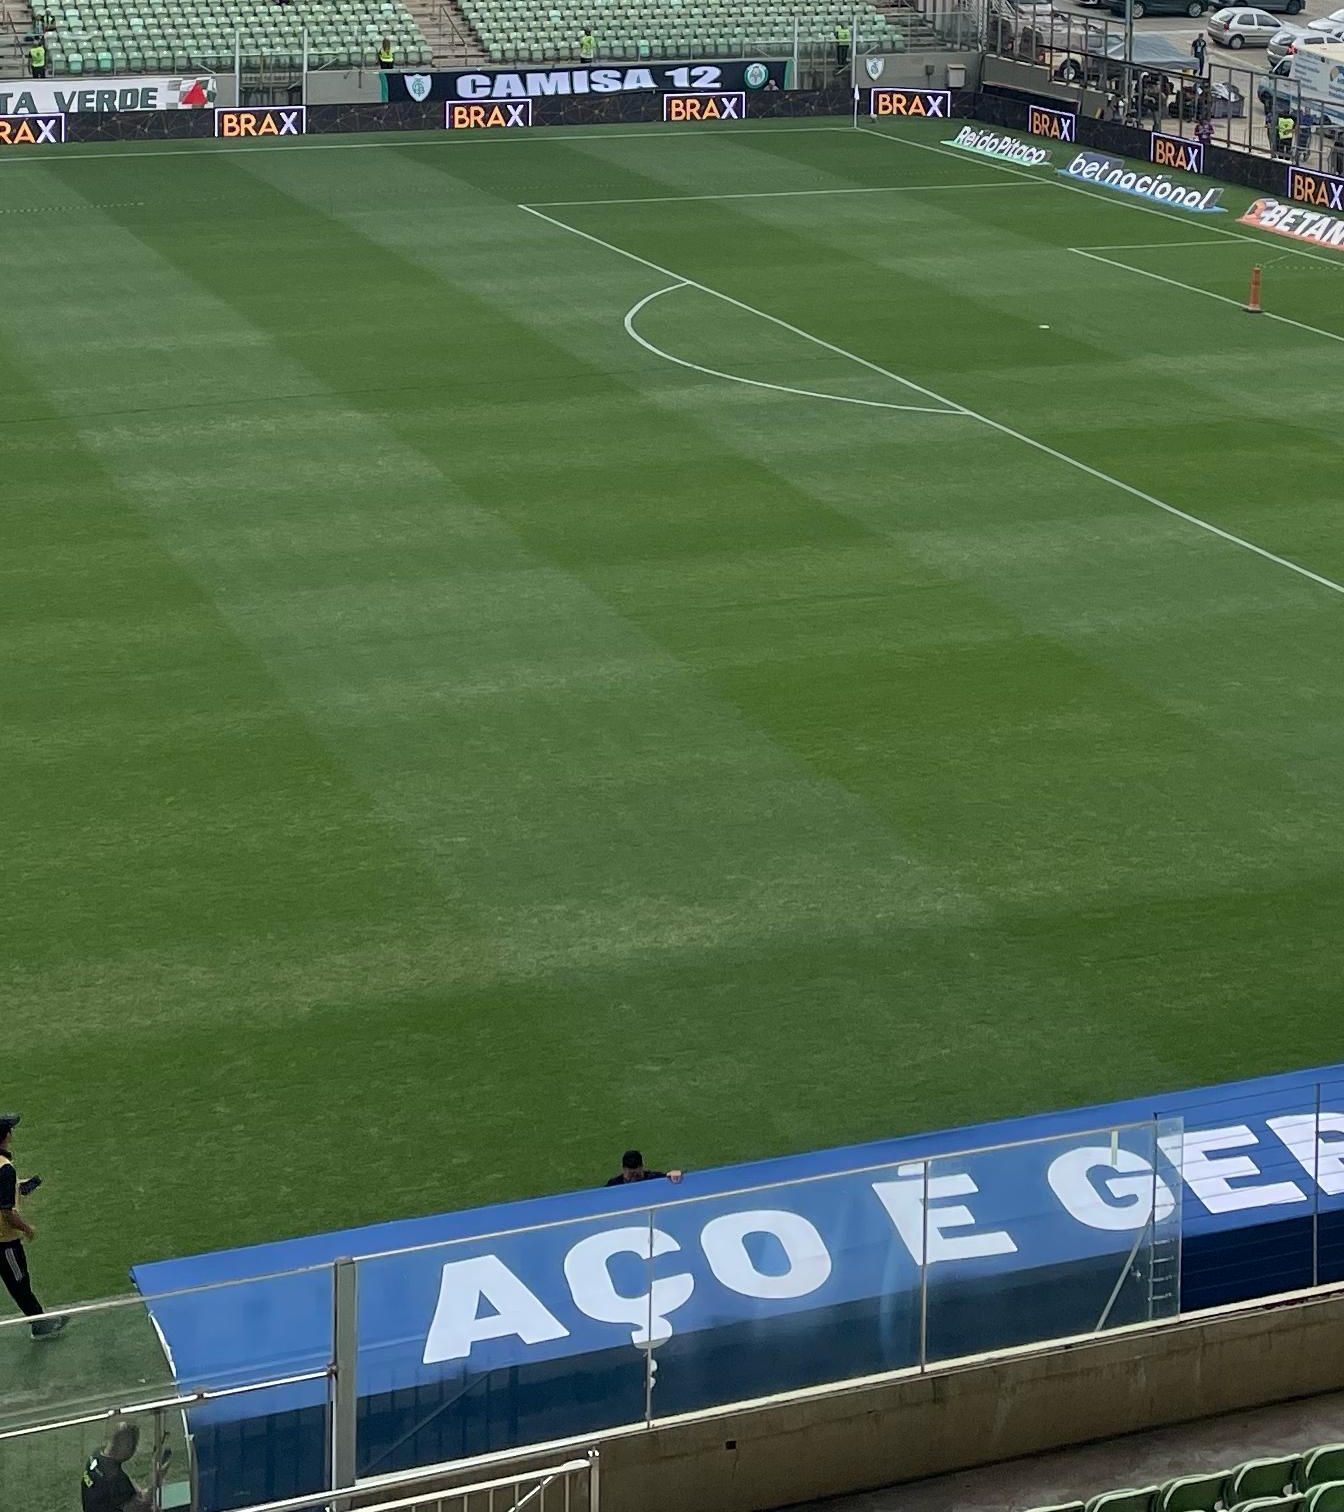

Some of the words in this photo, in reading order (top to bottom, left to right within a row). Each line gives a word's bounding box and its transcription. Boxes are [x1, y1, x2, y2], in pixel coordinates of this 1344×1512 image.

[456, 68, 657, 99] CAMISA
[666, 65, 723, 89] 12
[54, 87, 157, 112] VERDE
[671, 96, 738, 121] BRAX
[878, 93, 943, 118] BRAX
[223, 111, 298, 137] BRAX
[453, 103, 525, 129] BRAX
[1033, 111, 1071, 142] BRAX
[1156, 139, 1199, 174] BRAX
[1294, 174, 1343, 211] BRAX
[422, 1208, 833, 1364] AÇO
[871, 1158, 1016, 1265] É
